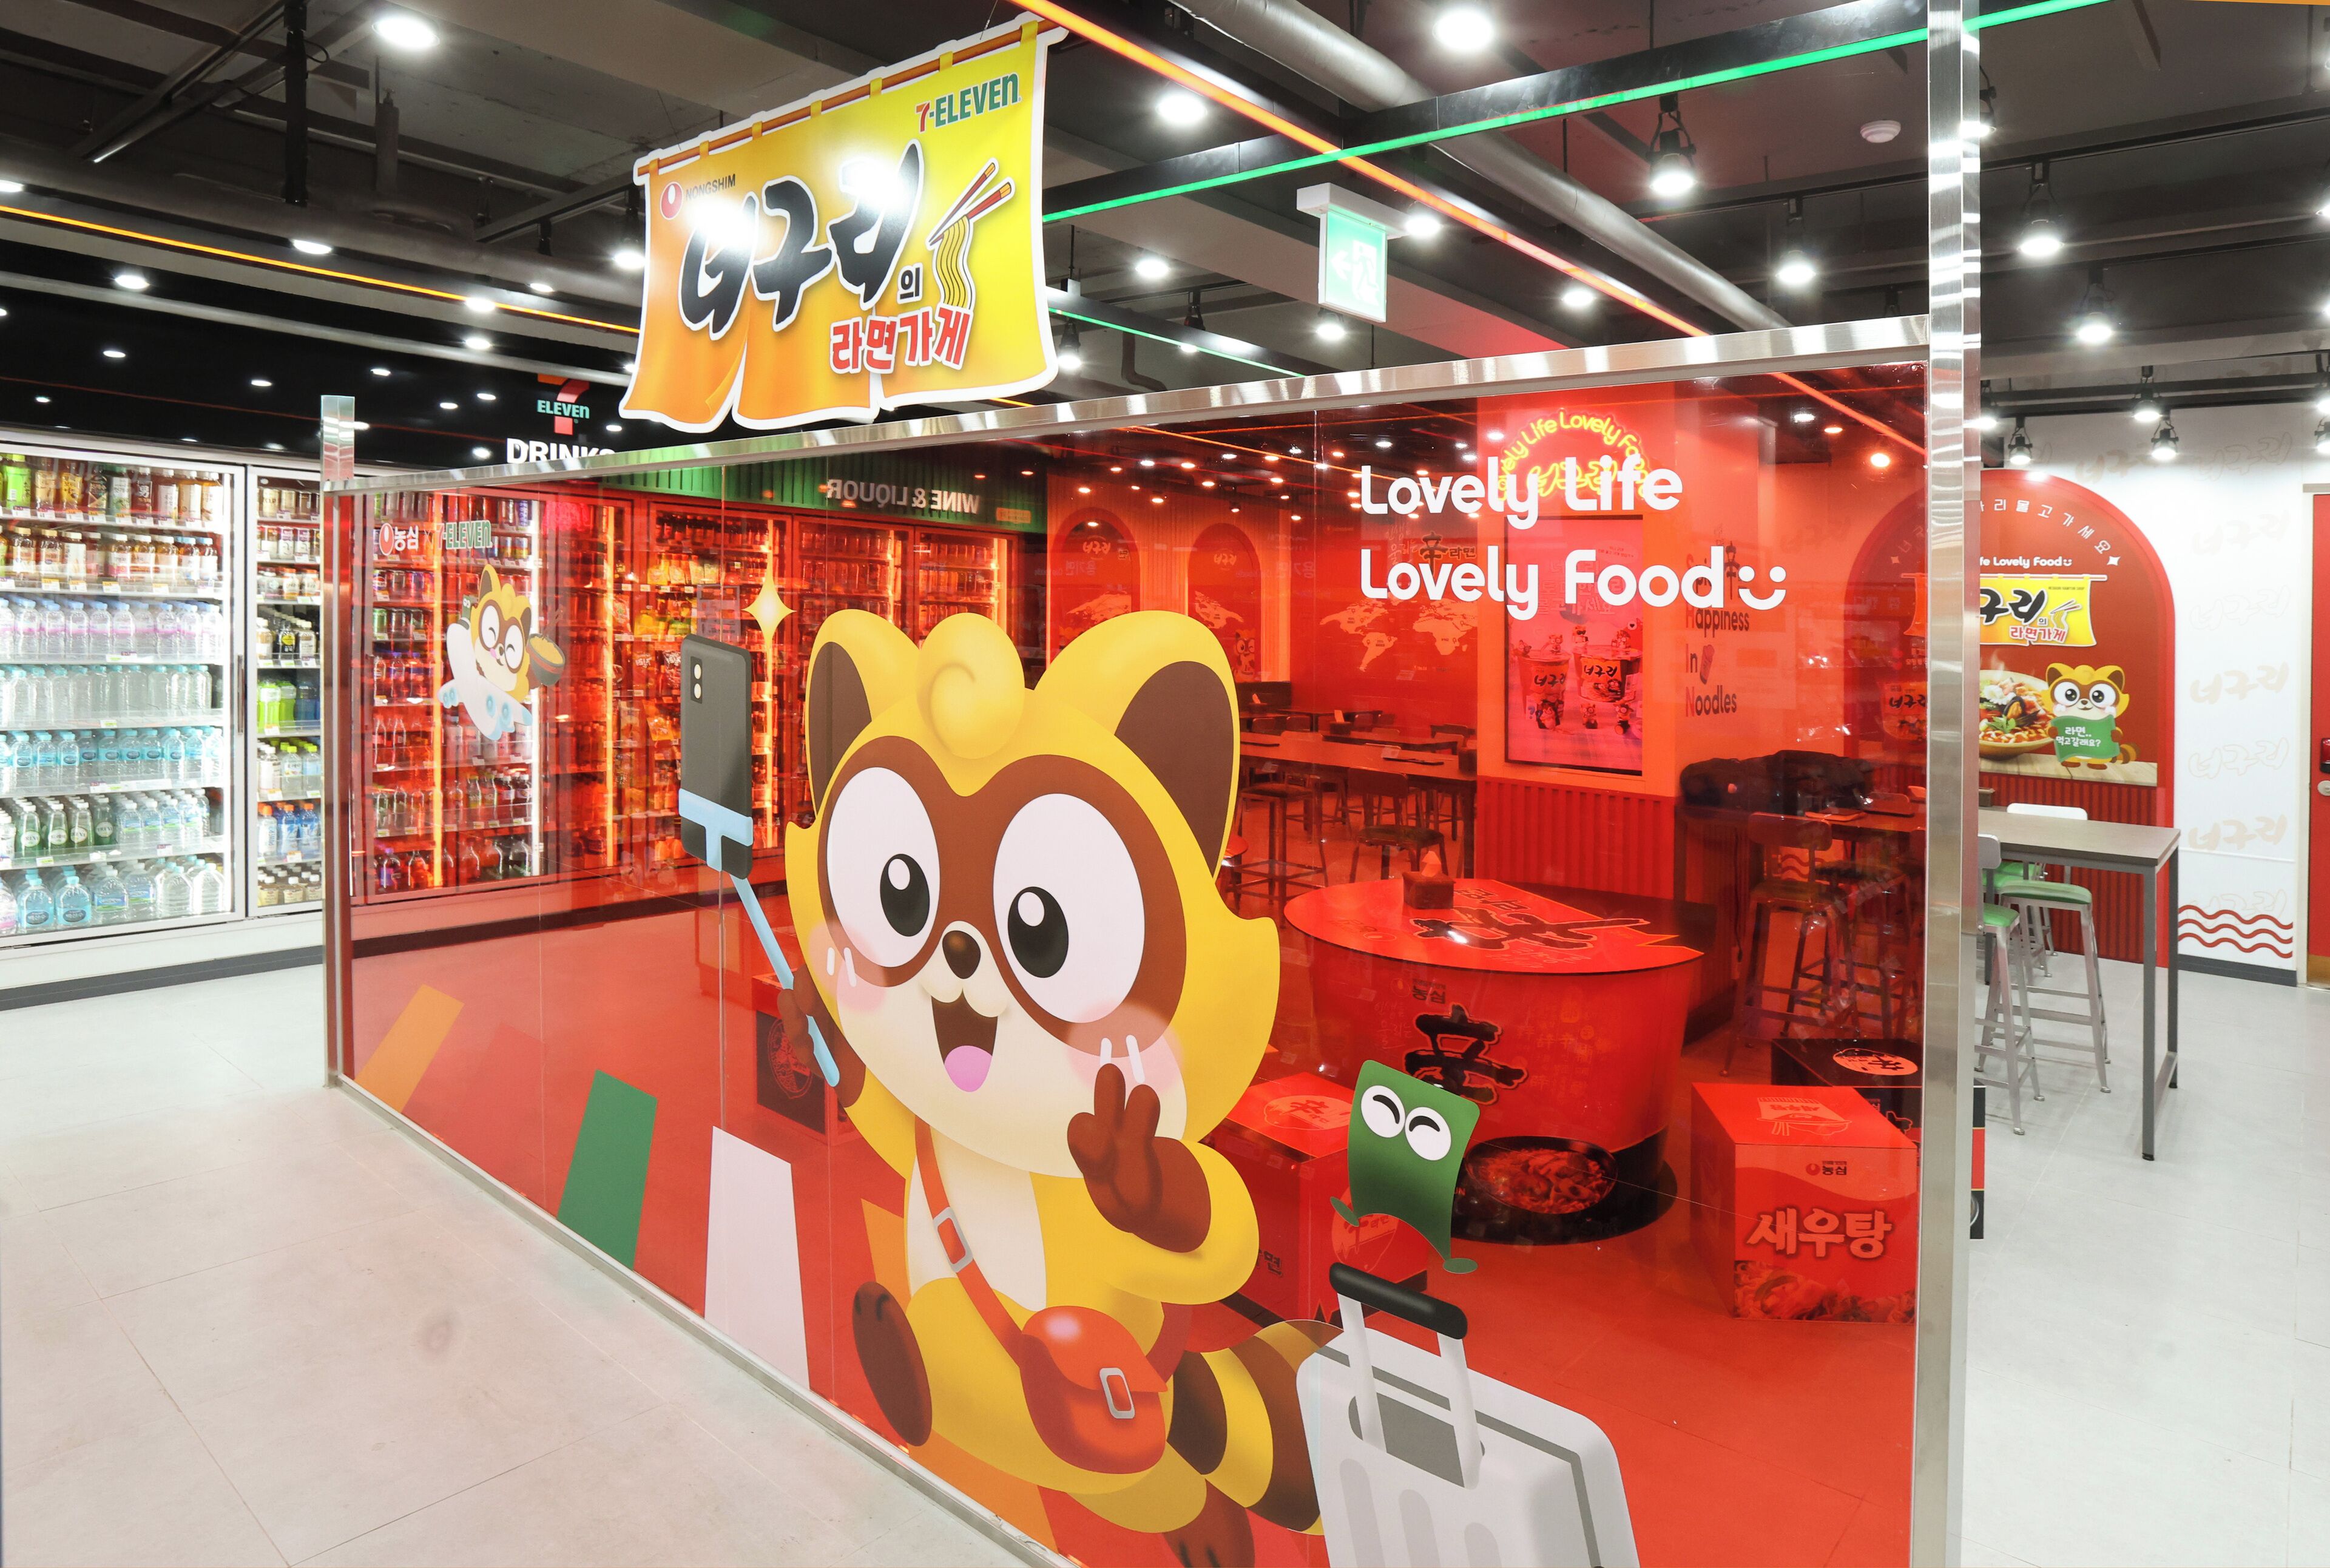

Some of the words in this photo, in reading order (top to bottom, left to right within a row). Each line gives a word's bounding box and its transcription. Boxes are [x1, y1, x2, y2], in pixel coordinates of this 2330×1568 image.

[686, 174, 735, 201] NONGSHIM
[900, 267, 920, 300] 의
[832, 307, 971, 370] 라면가게
[1559, 411, 1622, 445] Lovely
[507, 438, 615, 464] DRIN
[1361, 456, 1539, 530] Lovely
[1565, 455, 1683, 511] Life
[394, 525, 419, 551] 농심
[1993, 556, 2030, 569] Lovely
[2033, 556, 2062, 567] Food
[1361, 546, 1539, 621] Lovely
[1565, 546, 1724, 608] Food
[1686, 601, 1750, 638] Happiness
[2010, 626, 2066, 642] 라면가게
[1686, 685, 1737, 717] Noodles
[1822, 1165, 1847, 1175] 농심
[1747, 1207, 1892, 1259] 새우탕
